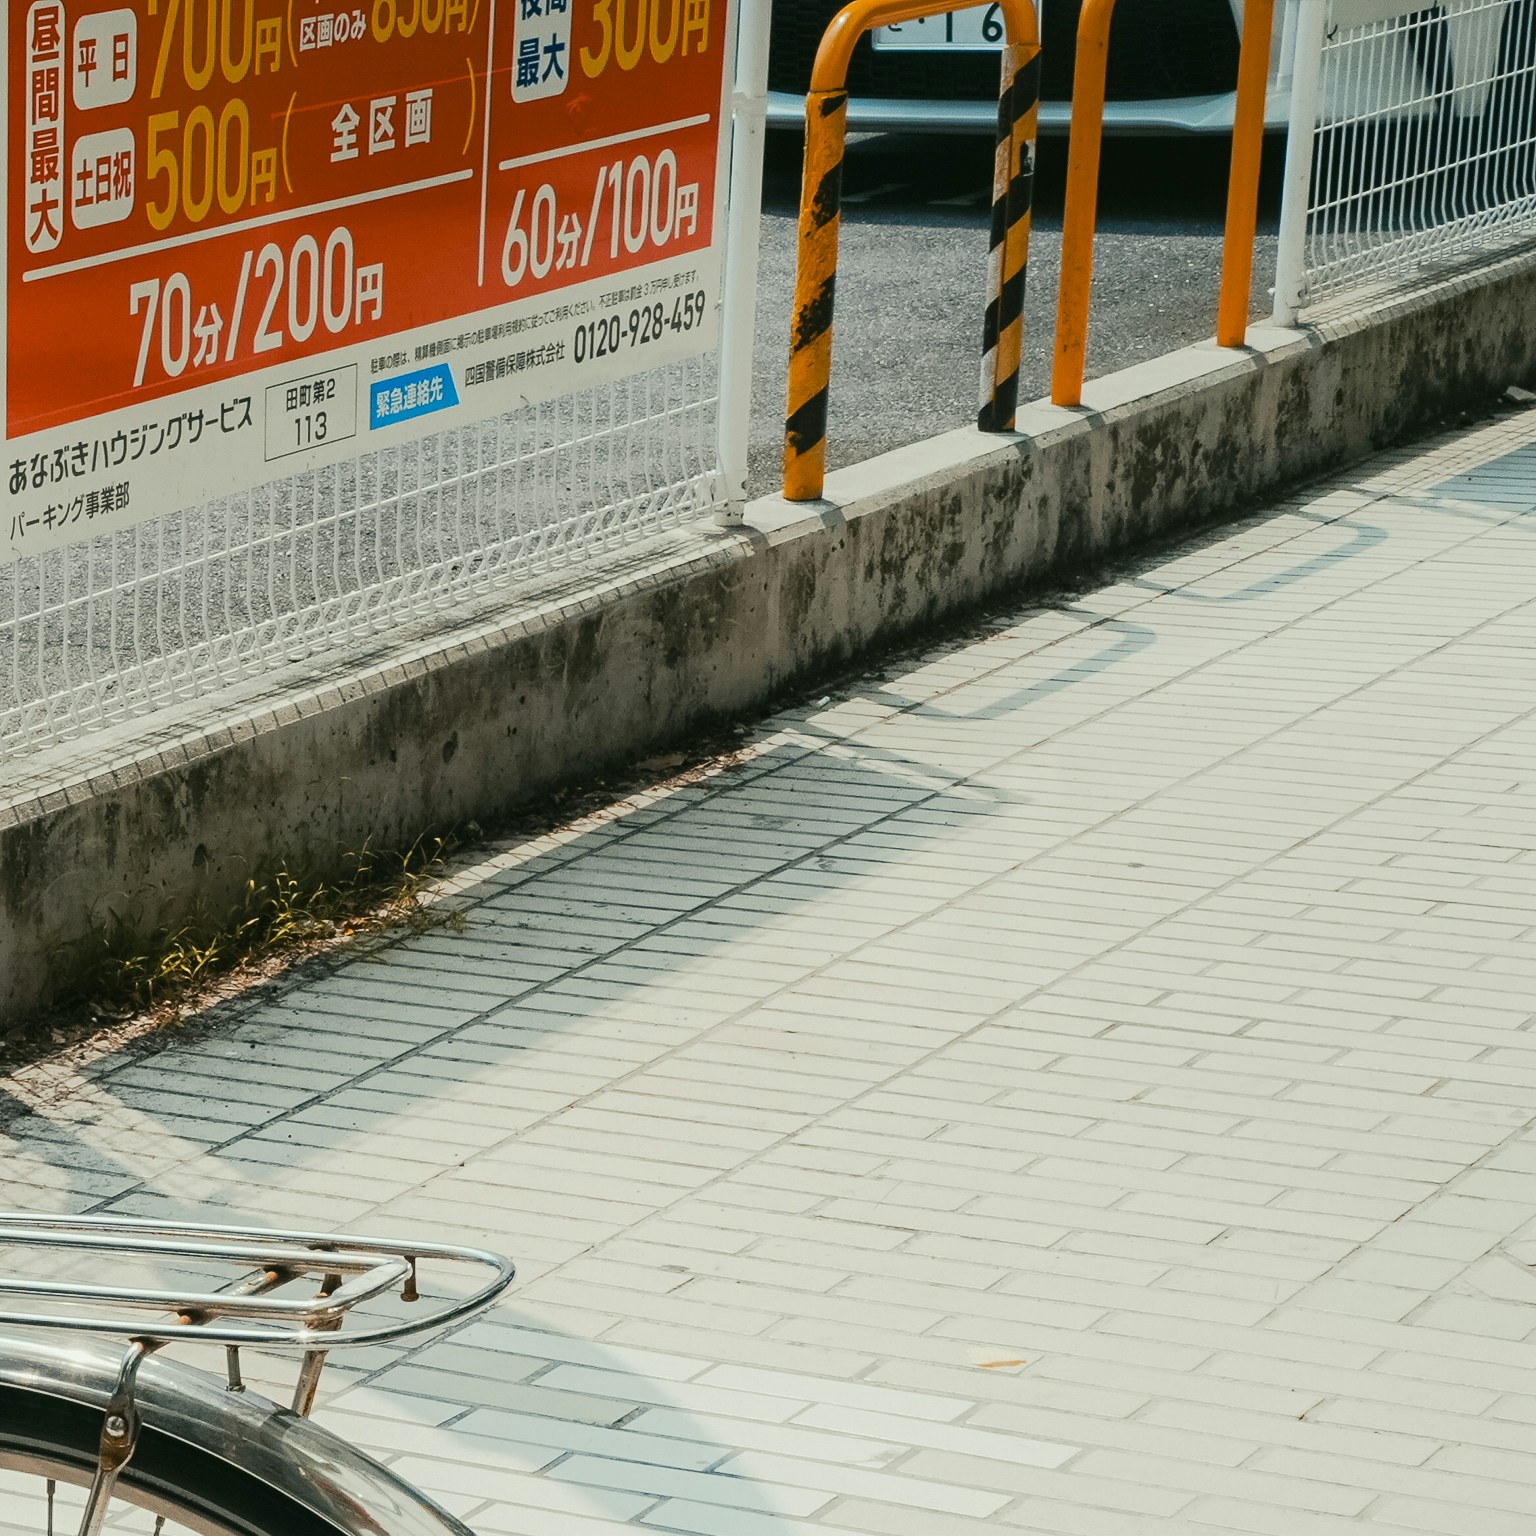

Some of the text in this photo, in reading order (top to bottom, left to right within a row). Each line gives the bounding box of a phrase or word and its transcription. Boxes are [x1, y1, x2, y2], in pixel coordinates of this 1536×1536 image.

[78, 34, 129, 88] 平日
[516, 33, 566, 88] 最大
[29, 6, 62, 246] 昼間最大
[74, 152, 133, 209] 土日祝
[501, 148, 699, 288] 60分/100円
[129, 226, 385, 388] 70分/200円
[574, 289, 706, 364] 0120-928-459
[285, 378, 337, 413] 田町第2
[375, 374, 445, 419] 緊急連絡先
[8, 395, 254, 496] あなぶきハウジングサービス
[294, 411, 328, 446] 113
[9, 480, 131, 541] パーキング事業部
